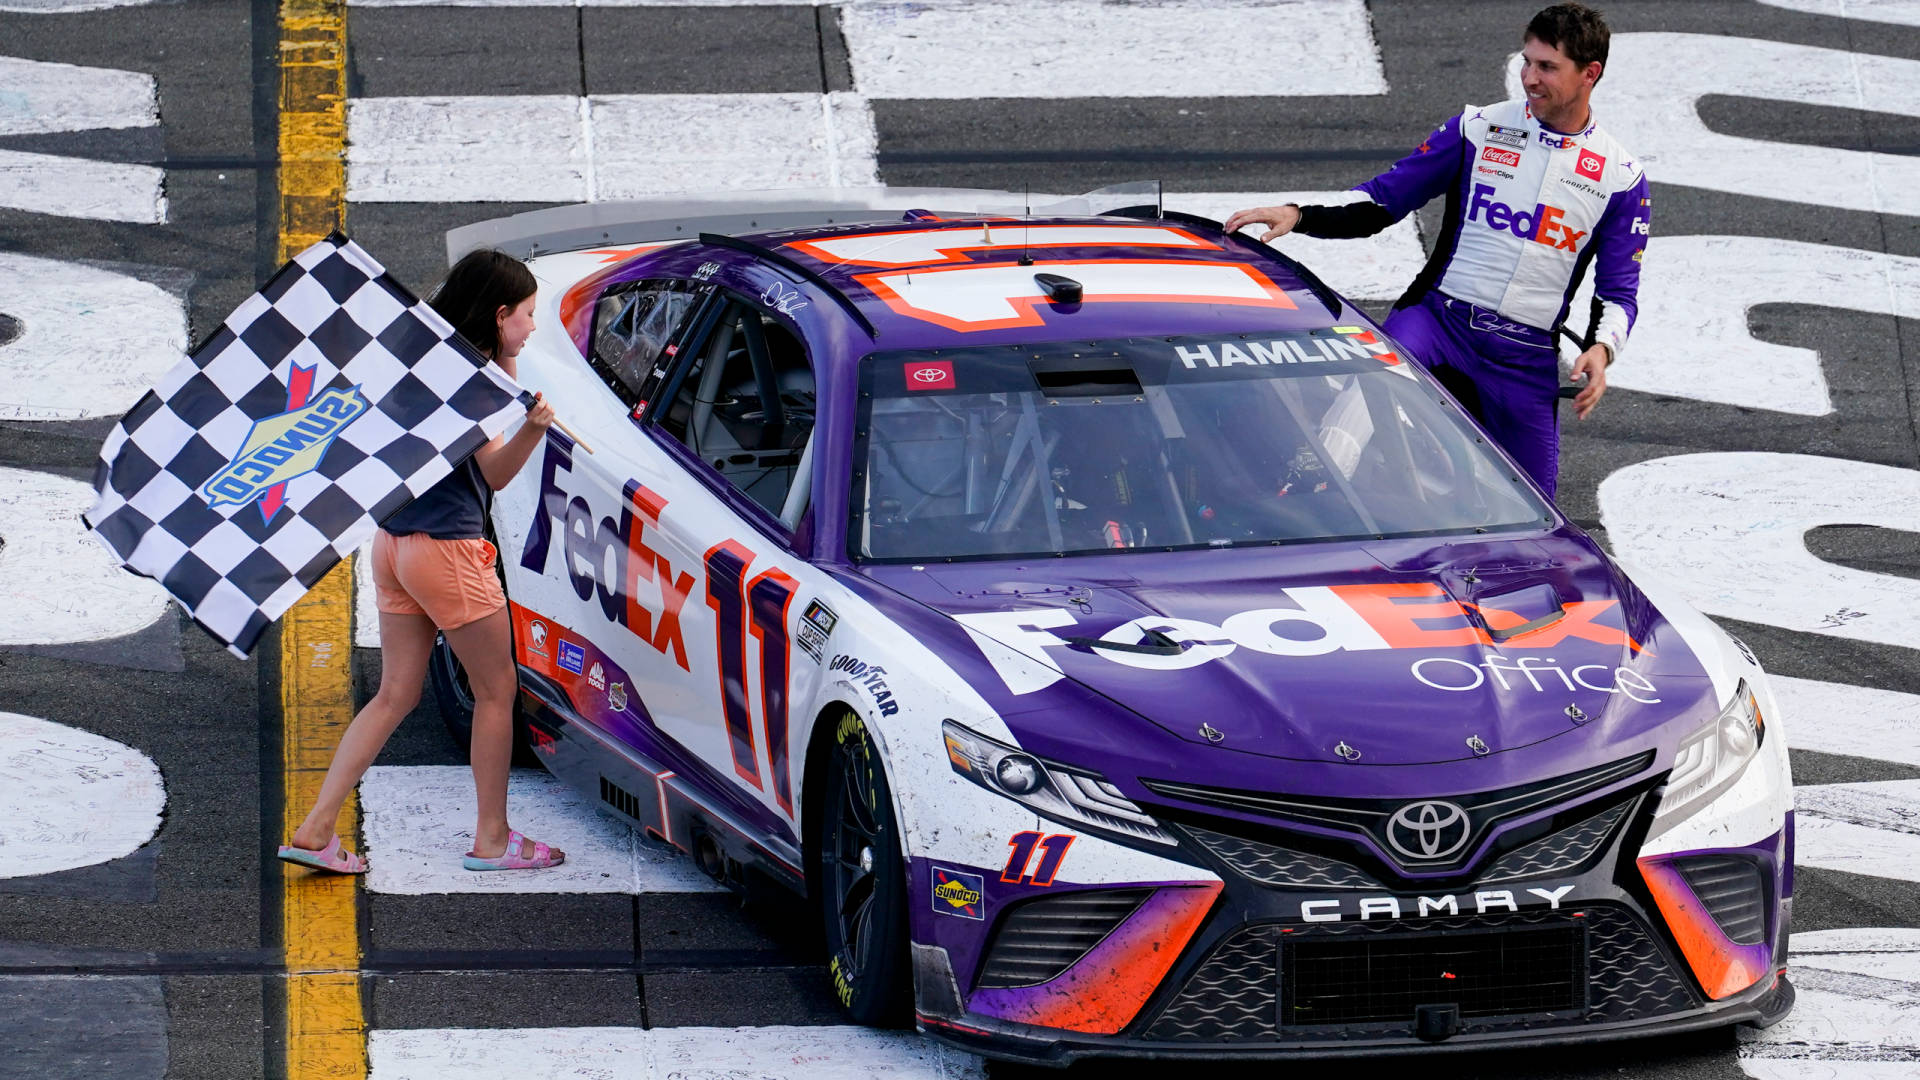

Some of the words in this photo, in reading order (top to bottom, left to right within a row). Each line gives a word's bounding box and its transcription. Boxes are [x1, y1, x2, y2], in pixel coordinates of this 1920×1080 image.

[1538, 131, 1577, 149] FedEx
[1467, 182, 1588, 253] FedEx
[1174, 337, 1372, 369] HAMLIN
[520, 427, 696, 673] FedEx
[952, 584, 1657, 696] FedEx
[703, 538, 801, 822] 11
[829, 654, 899, 718] GOODYEAR
[1411, 657, 1661, 704] Office
[1000, 830, 1077, 887] 11
[936, 885, 978, 903] SUNOCO
[1300, 885, 1576, 922] CAMRY
